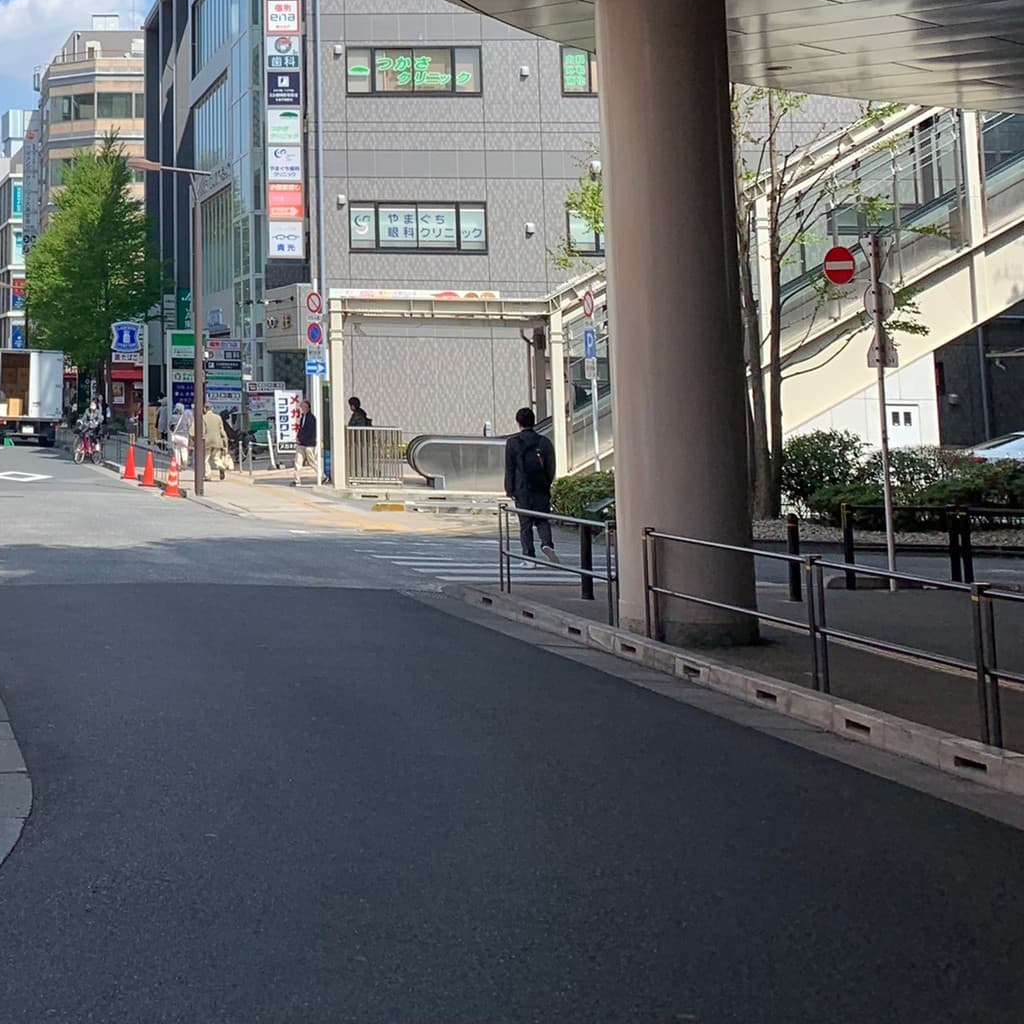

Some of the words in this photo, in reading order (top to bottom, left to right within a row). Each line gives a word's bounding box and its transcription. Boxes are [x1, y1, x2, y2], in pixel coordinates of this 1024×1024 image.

[270, 13, 295, 21] ena
[397, 71, 472, 85] クリニック
[388, 214, 445, 225] やまぐち
[290, 395, 301, 432] メガネ
